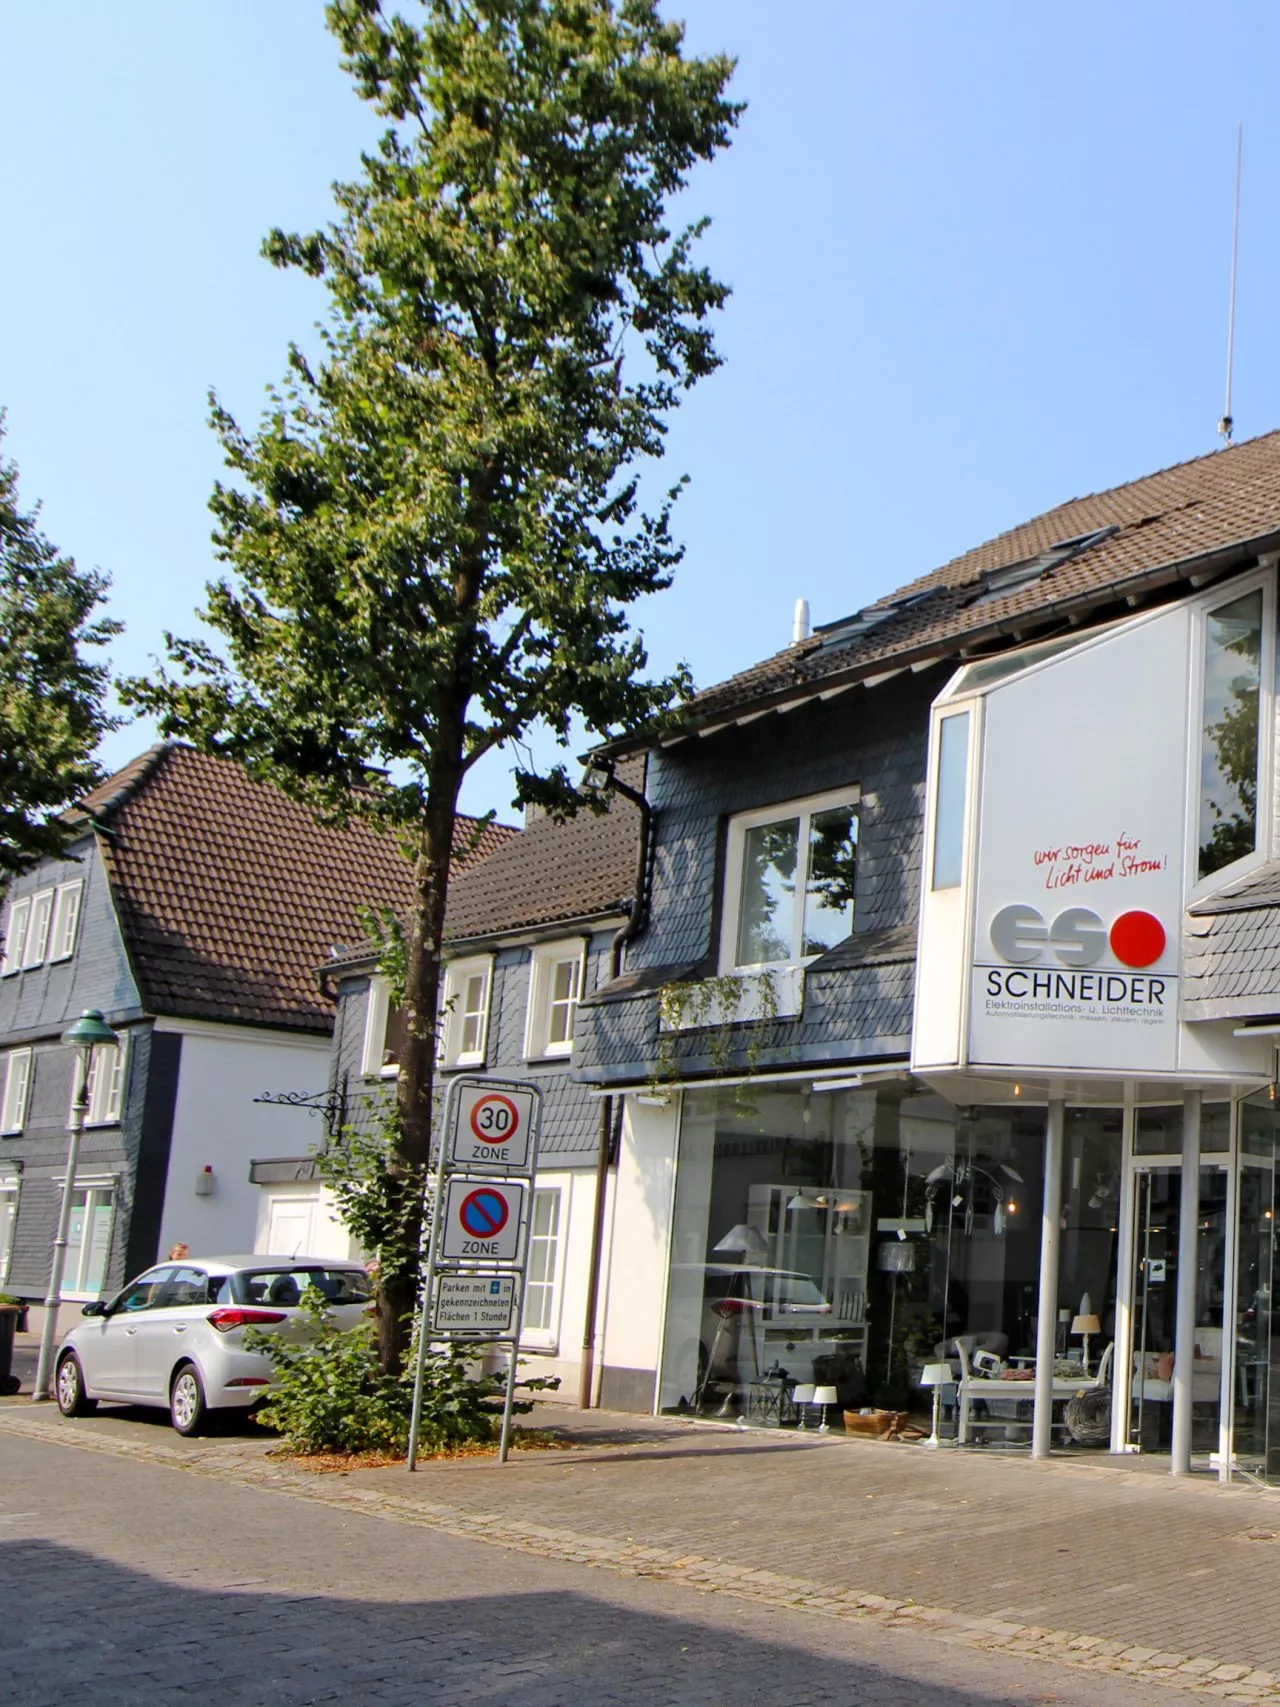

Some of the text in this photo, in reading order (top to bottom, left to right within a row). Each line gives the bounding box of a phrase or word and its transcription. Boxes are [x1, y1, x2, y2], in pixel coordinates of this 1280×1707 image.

[1034, 832, 1142, 865] wir sorgen für
[1045, 855, 1168, 889] Licht und Strom!
[987, 970, 1165, 1005] SCHNEIDER
[985, 1000, 1165, 1017] Elektroinstallations- u. Lichttechnik
[480, 1107, 509, 1131] 30
[472, 1145, 510, 1161] ZONE
[462, 1241, 500, 1255] ZONE
[442, 1282, 511, 1292] Parken mit in
[440, 1297, 510, 1309] gekennzeichneten
[440, 1311, 470, 1321] Flächen
[480, 1312, 507, 1321] Stunde
